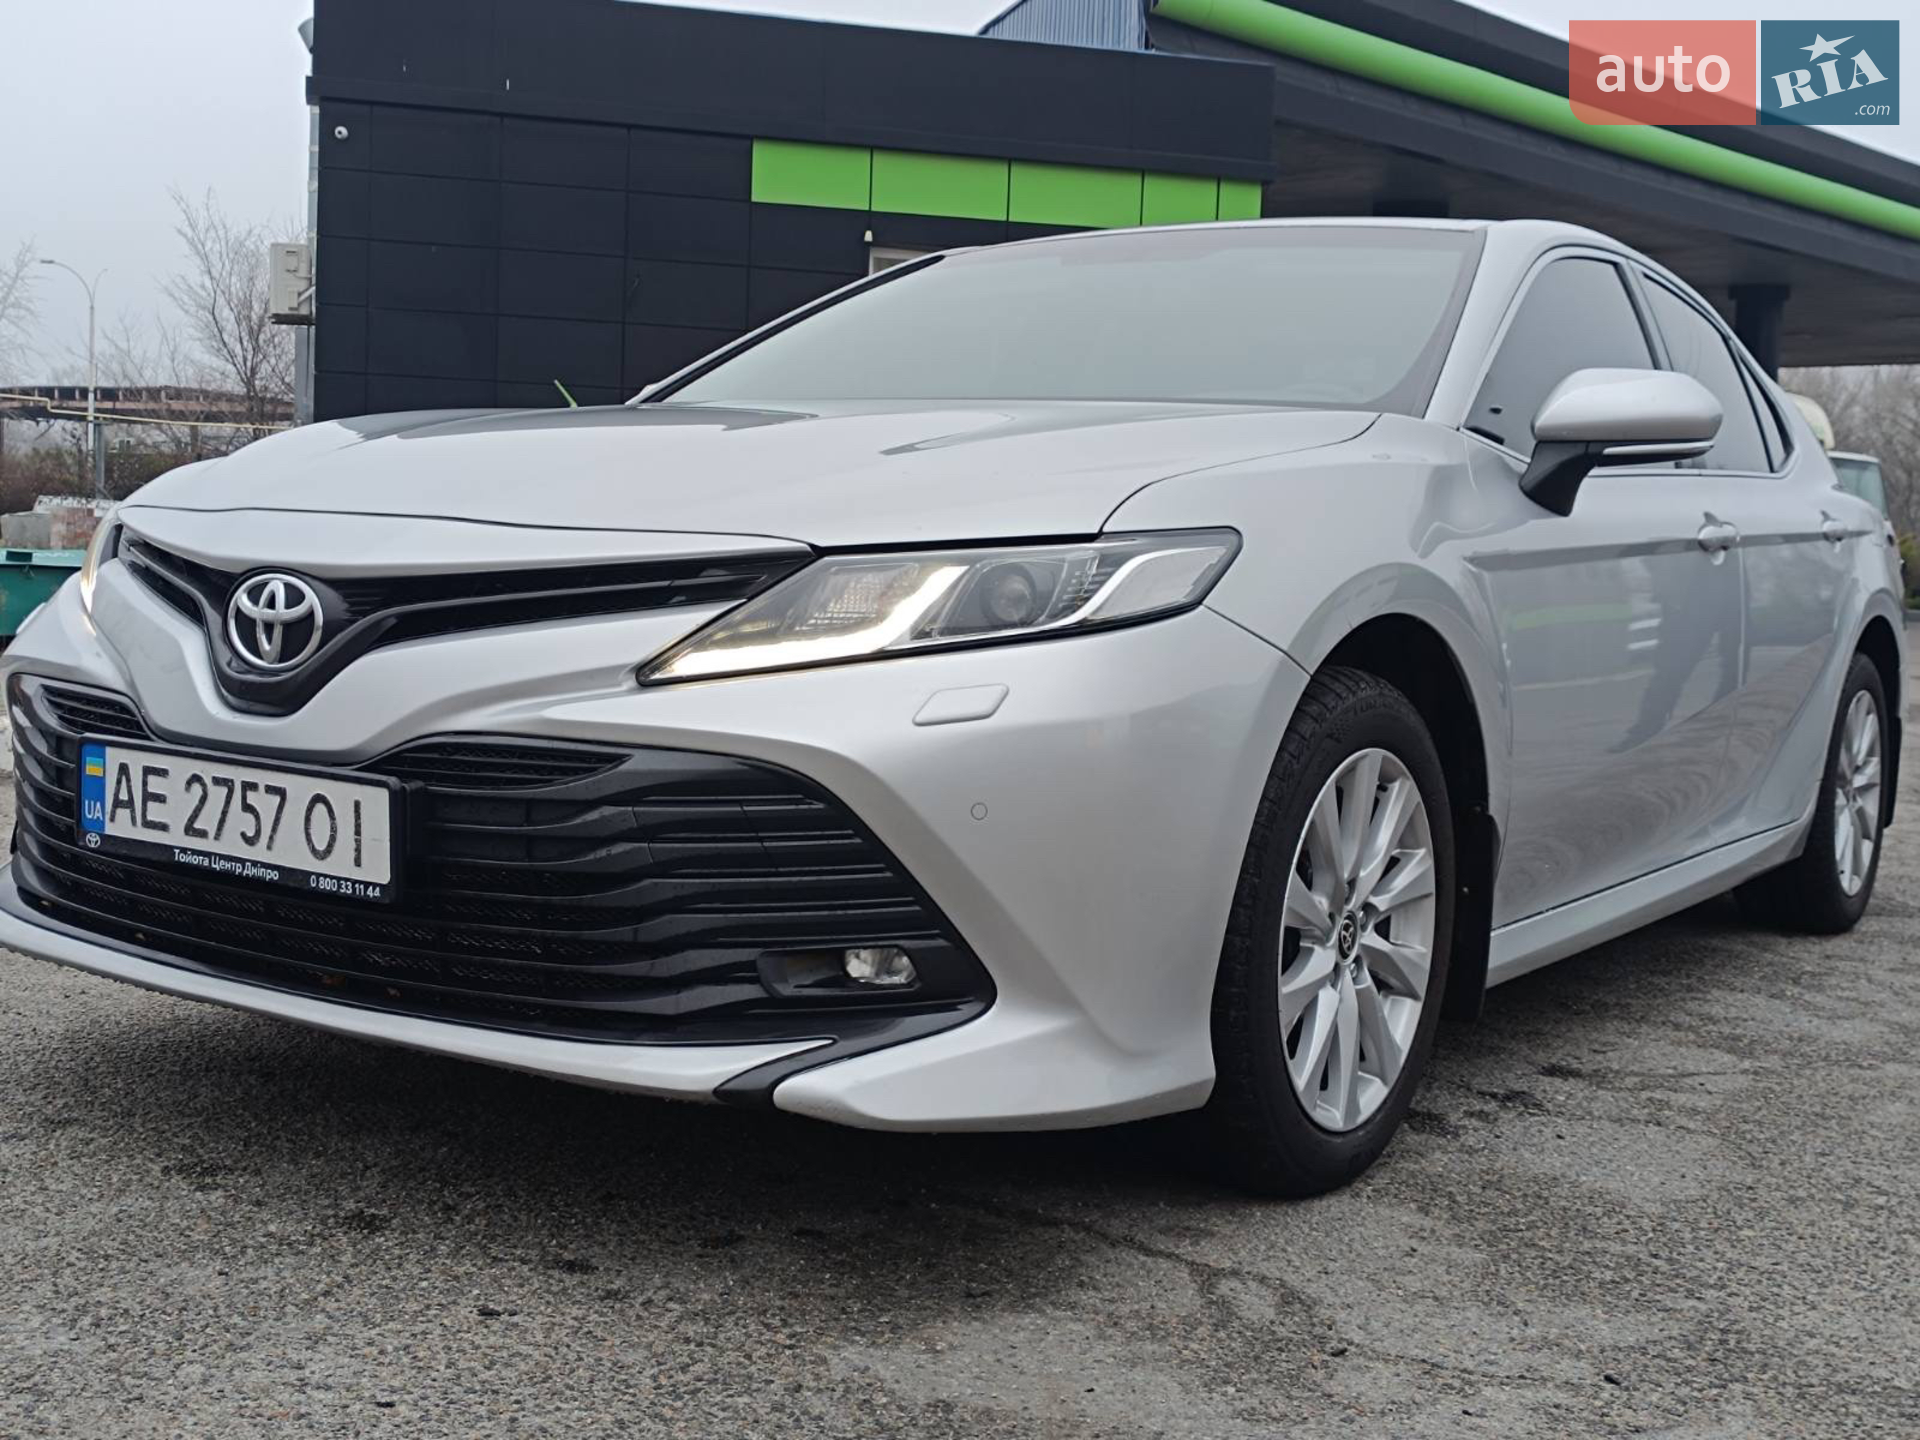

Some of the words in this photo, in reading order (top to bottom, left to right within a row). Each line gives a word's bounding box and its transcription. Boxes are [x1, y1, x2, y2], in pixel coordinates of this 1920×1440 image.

[85, 800, 103, 821] UA
[109, 762, 170, 832] AE
[184, 773, 287, 851] 2757
[173, 849, 209, 866] Тойота
[211, 856, 242, 874] Центр
[243, 862, 279, 881] Дніпро
[310, 875, 316, 887] 0
[318, 877, 337, 891] 800
[339, 881, 352, 894] 33
[355, 883, 364, 896] 11
[366, 886, 380, 898] 44
